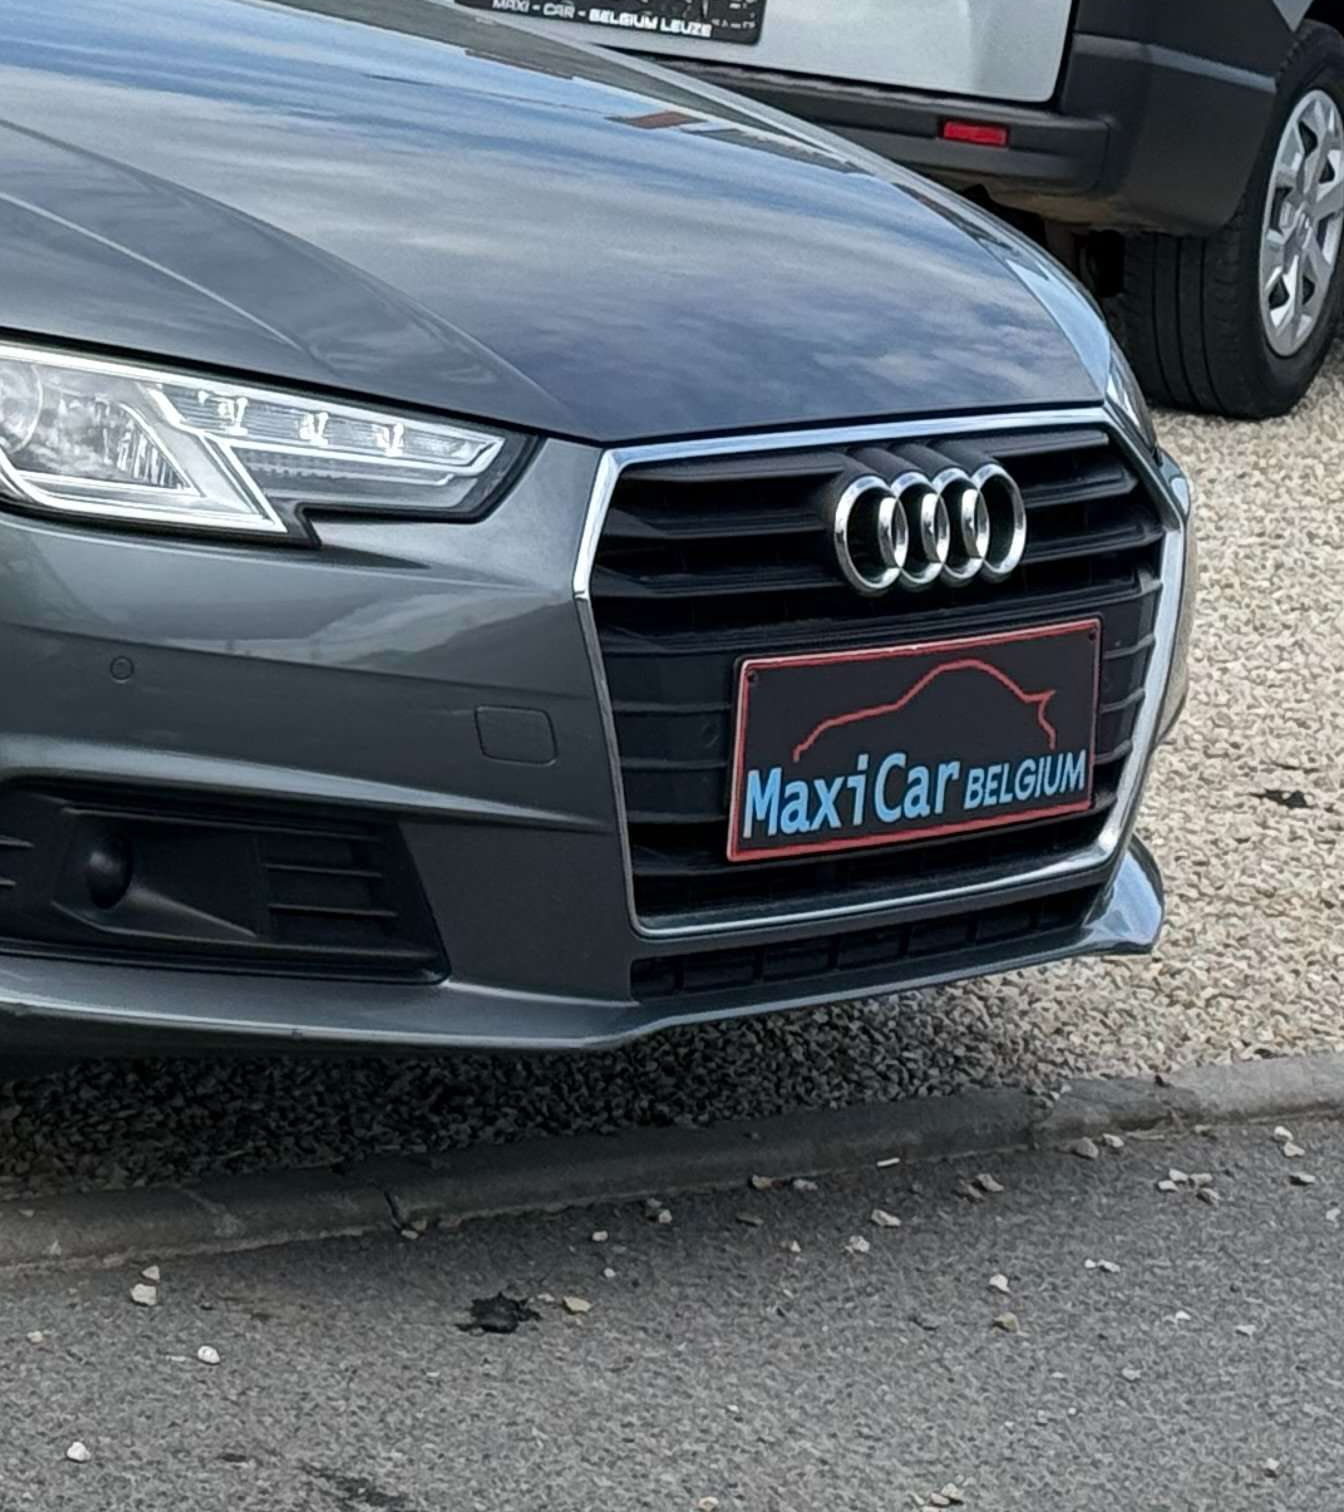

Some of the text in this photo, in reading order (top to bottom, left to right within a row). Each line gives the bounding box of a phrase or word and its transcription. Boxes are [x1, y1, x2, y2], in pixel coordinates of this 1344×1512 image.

[543, 2, 575, 19] CAR
[589, 8, 659, 30] BELGIUM
[743, 750, 1087, 839] MaxiCar BELGIUM
